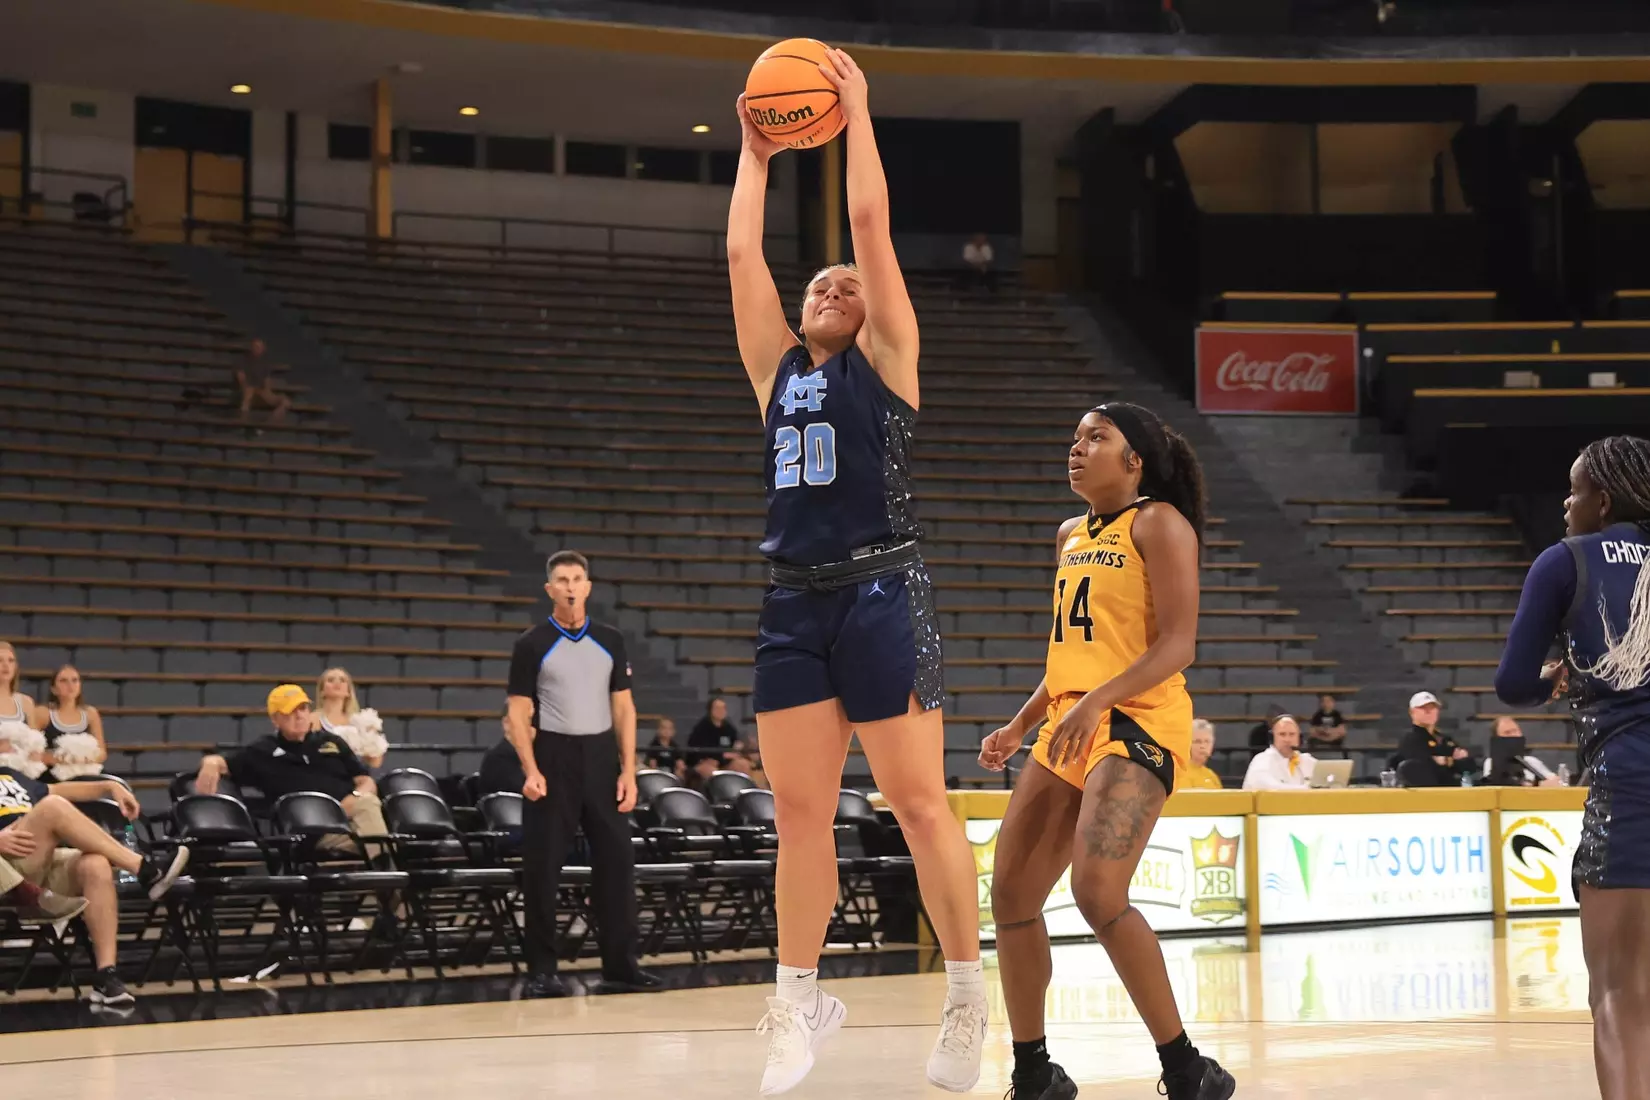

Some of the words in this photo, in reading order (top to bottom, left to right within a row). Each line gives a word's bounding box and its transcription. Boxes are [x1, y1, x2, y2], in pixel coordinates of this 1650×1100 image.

[749, 105, 815, 126] Wilson
[774, 422, 837, 490] 20
[1092, 549, 1126, 569] MISS
[1601, 540, 1650, 565] CHOC
[1054, 575, 1095, 644] 14
[1328, 835, 1485, 877] AIRSOUTH
